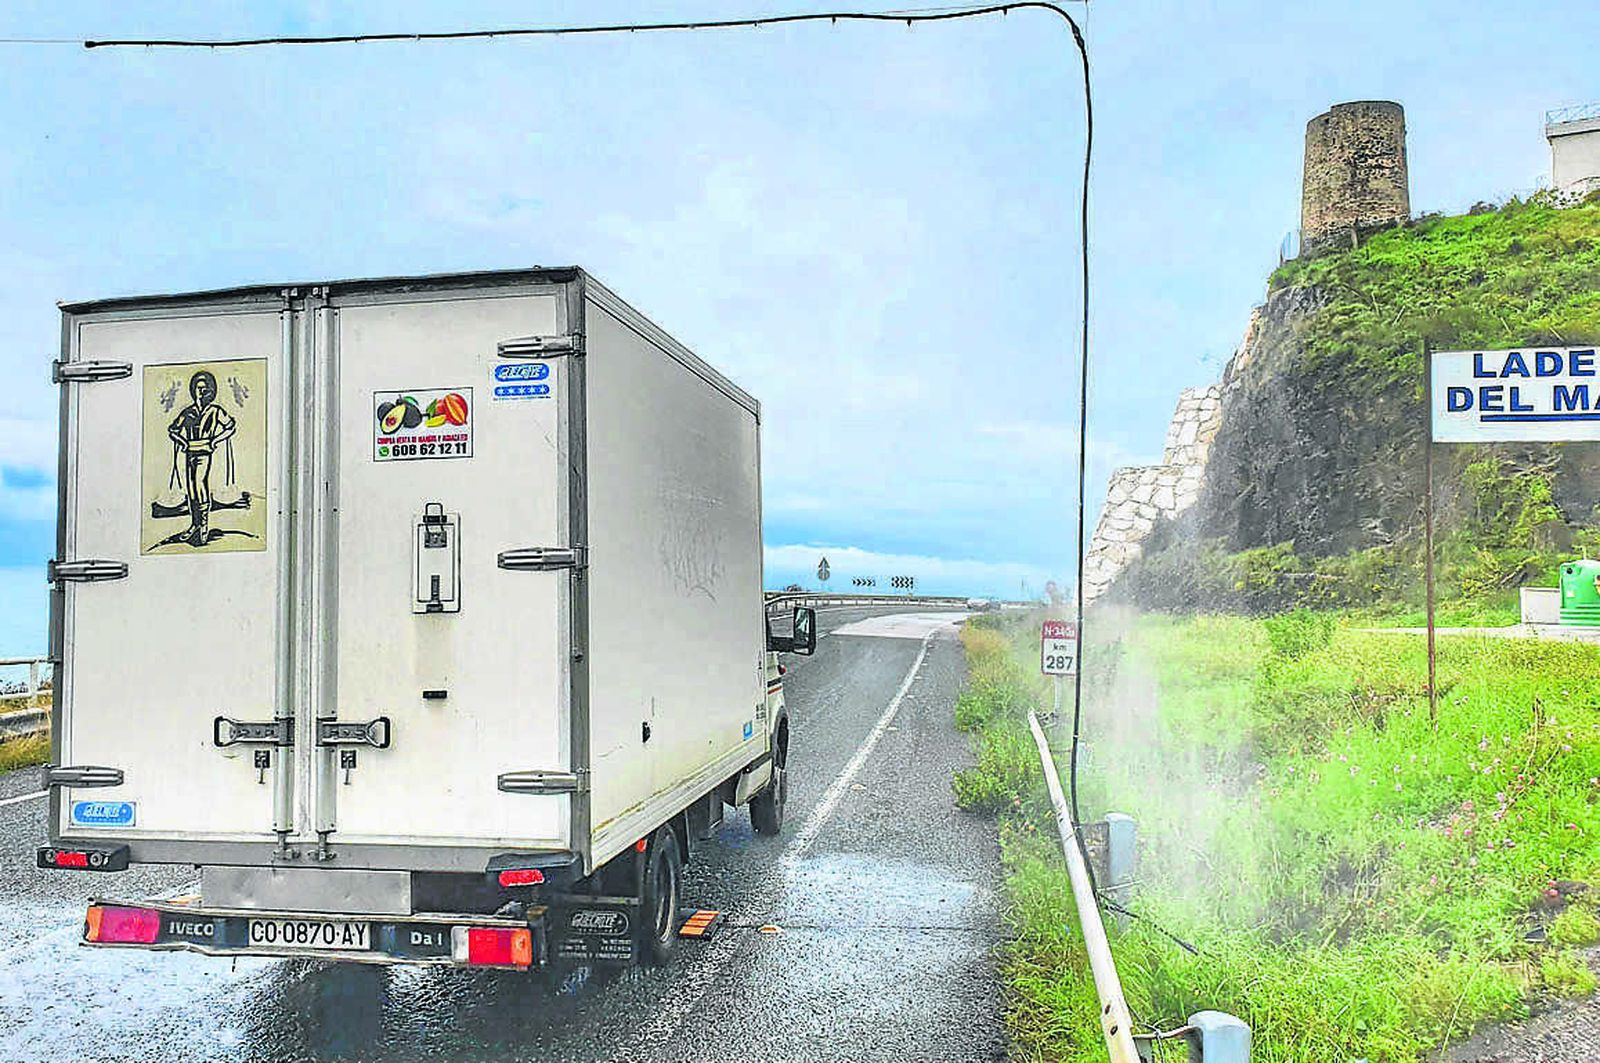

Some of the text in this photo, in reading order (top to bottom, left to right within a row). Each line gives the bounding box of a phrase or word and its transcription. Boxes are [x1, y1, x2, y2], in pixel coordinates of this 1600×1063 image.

[1473, 349, 1596, 378] LADE
[1447, 385, 1600, 412] DEL M
[392, 442, 467, 456] 608 62 12 11
[1053, 642, 1067, 650] km
[1046, 655, 1074, 671] 287
[169, 921, 214, 936] IVECO
